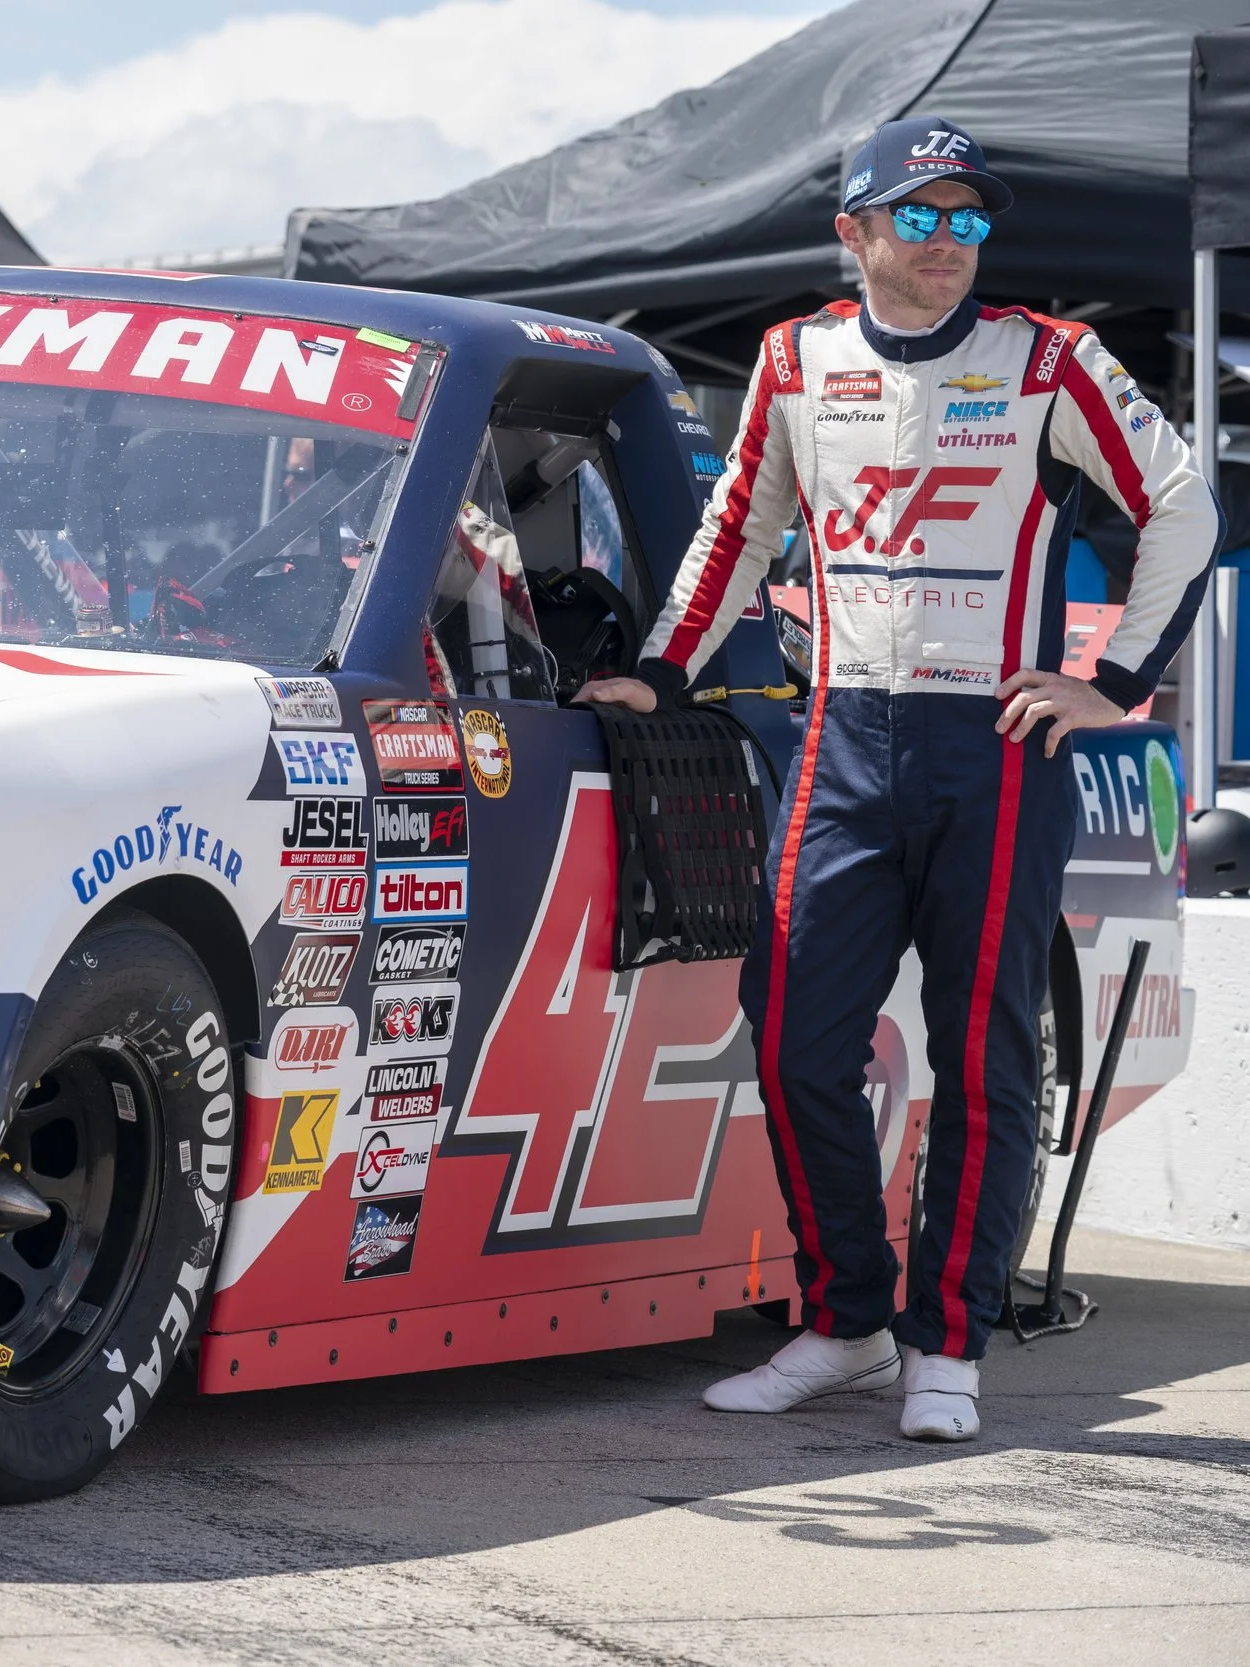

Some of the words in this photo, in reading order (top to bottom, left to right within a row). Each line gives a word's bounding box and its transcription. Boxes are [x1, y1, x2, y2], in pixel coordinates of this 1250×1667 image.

[909, 163, 966, 172] ELECTR
[770, 329, 791, 384] sparco
[1036, 329, 1071, 383] sparco
[827, 381, 879, 391] CRAFTSMAN
[945, 401, 1009, 418] NIECE
[691, 452, 727, 475] NIEC
[836, 664, 869, 676] sparco
[953, 668, 992, 677] MATT
[274, 704, 302, 718] RACE
[302, 704, 337, 718] TRUCK
[400, 707, 428, 721] NASCAR
[465, 714, 500, 741] NASCAR
[375, 734, 456, 758] CRAFTSMAN
[280, 741, 355, 785] SKF
[404, 773, 421, 785] TRUCK
[421, 773, 440, 785] SERIES
[470, 760, 510, 794] INTERNATIONAL
[282, 800, 367, 848] JESEL
[376, 804, 431, 852] Holley
[291, 853, 310, 863] SHAFT
[313, 853, 336, 863] ROCKER
[339, 853, 356, 863] ARMS
[283, 875, 367, 917] CALICO
[380, 874, 462, 912] tilton
[324, 918, 362, 928] COATINGS
[375, 936, 462, 971] COMETIC
[284, 946, 353, 988] KLOTZ
[379, 971, 412, 980] GASKET
[370, 995, 455, 1045] KOOKS
[368, 1065, 433, 1093] LINCOLN
[378, 1095, 434, 1118] WELDERS
[266, 1169, 321, 1189] KENNAMETAL
[350, 1212, 419, 1245] Arrowhead
